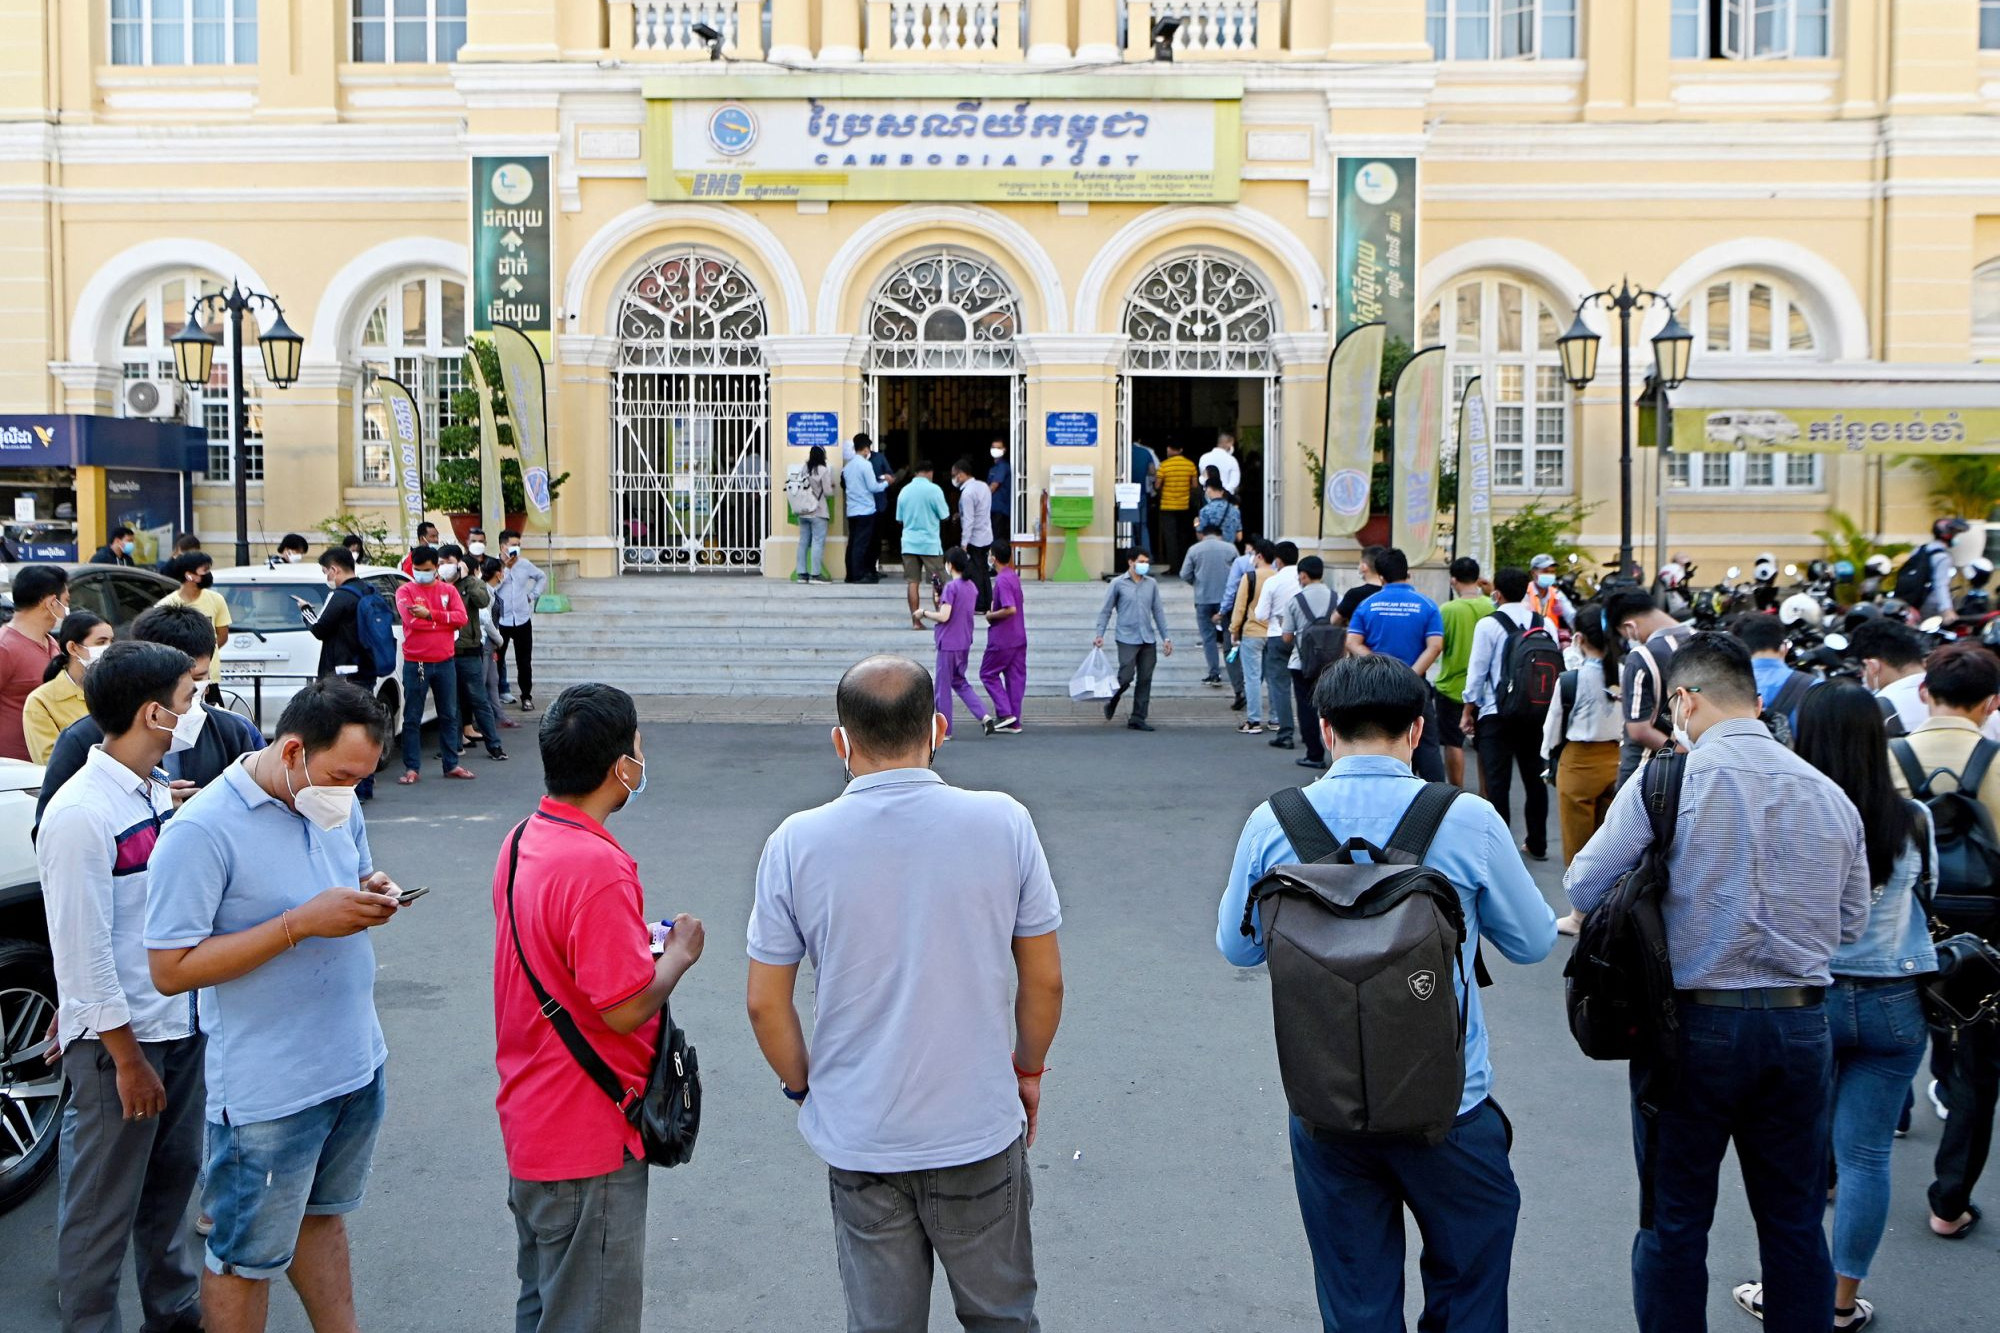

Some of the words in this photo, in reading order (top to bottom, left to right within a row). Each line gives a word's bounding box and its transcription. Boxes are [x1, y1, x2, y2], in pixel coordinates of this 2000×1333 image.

[814, 153, 1017, 167] CAMBODIA
[1041, 153, 1138, 167] POST
[692, 173, 742, 196] EMS
[402, 444, 415, 466] 21
[404, 469, 420, 489] 00
[407, 494, 421, 514] 18
